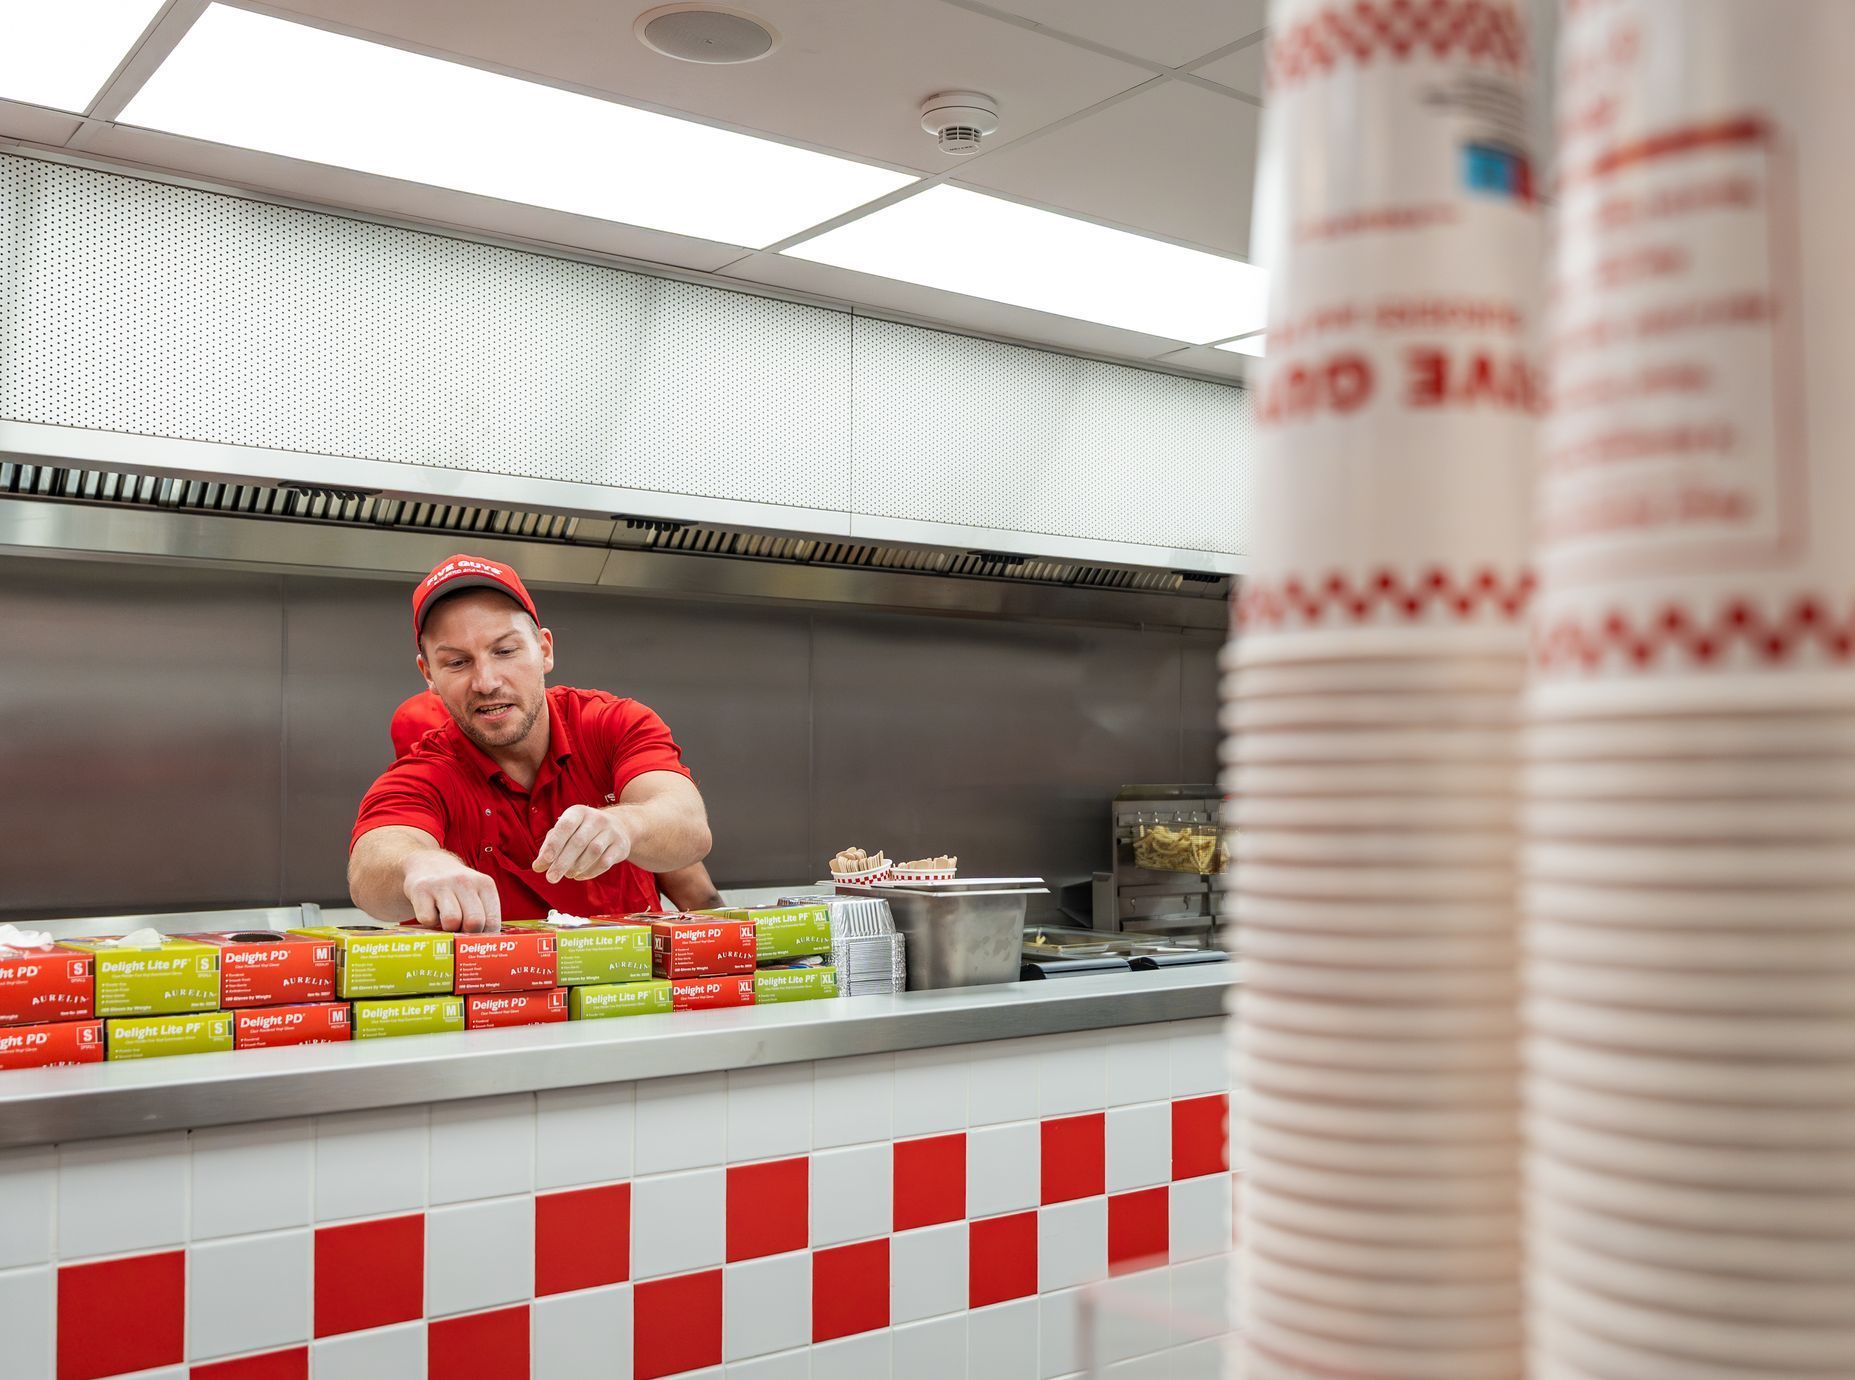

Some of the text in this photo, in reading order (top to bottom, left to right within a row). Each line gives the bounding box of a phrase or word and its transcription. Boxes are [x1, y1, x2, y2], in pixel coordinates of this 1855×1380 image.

[426, 563, 455, 587] FIVE
[458, 560, 503, 575] GUYS
[754, 912, 809, 926] Delight Lite PF
[815, 912, 825, 922] XL
[675, 928, 721, 941] Delight PD
[741, 927, 752, 937] XL
[543, 940, 550, 951] L
[560, 936, 627, 948] Delight Lite PF
[637, 935, 644, 945] L
[655, 937, 663, 951] XL
[316, 947, 327, 959] M
[352, 941, 427, 955] Delight Lite PF
[436, 942, 447, 954] M
[459, 941, 516, 955] Delight PD
[225, 950, 288, 965] Delight PD
[717, 951, 753, 960] AURELIA
[73, 962, 83, 975] S
[102, 958, 188, 974] Delight Lite PF
[201, 958, 209, 970] S
[17, 965, 38, 978] PD
[510, 966, 552, 976] AURELIA
[283, 976, 330, 987] AURELIA
[757, 974, 816, 987] Delight Lite PF
[821, 974, 833, 984] XL
[673, 983, 720, 997] Delight PD
[740, 982, 751, 992] XL
[553, 995, 559, 1006] L
[586, 991, 649, 1005] Delight Lite PF
[658, 991, 665, 1001] L
[472, 997, 527, 1011] Delight PD
[332, 1010, 343, 1022] M
[362, 1004, 437, 1019] Delight Lite PF
[446, 1005, 456, 1016] M
[240, 1013, 303, 1029] Delight PD
[115, 1023, 201, 1040] Delight Lite PF
[214, 1022, 223, 1034] S
[26, 1033, 47, 1045] PD
[83, 1029, 93, 1042] S
